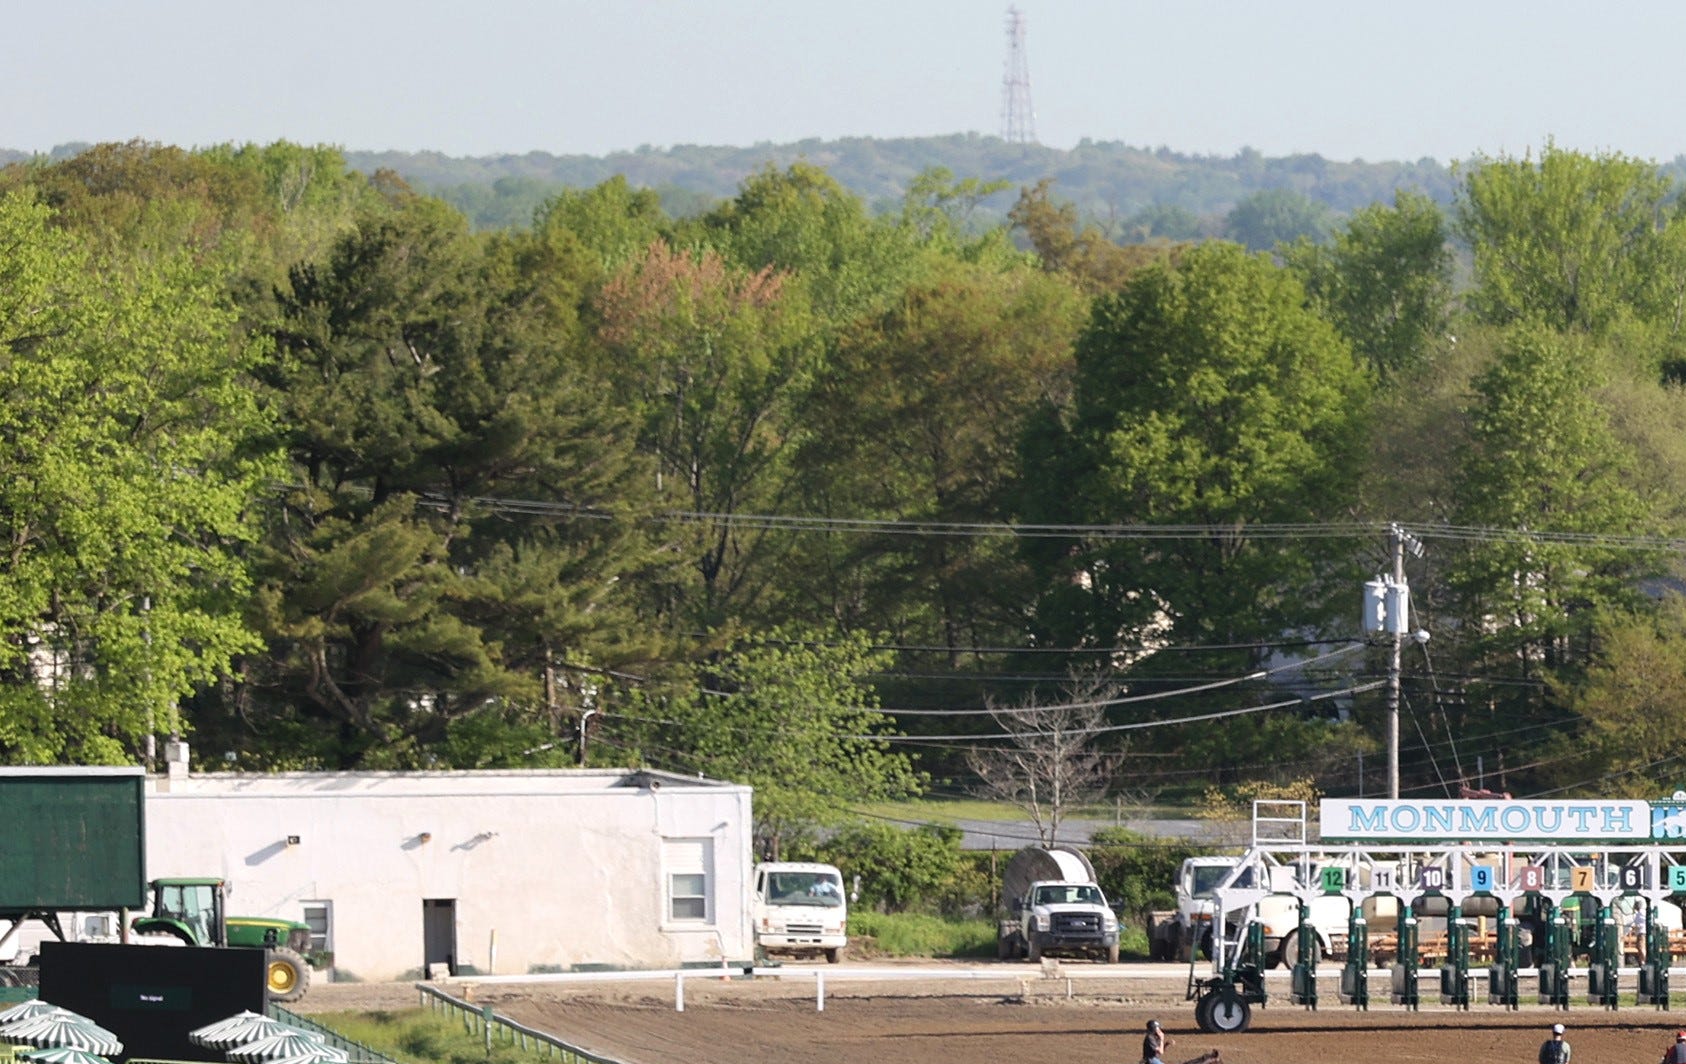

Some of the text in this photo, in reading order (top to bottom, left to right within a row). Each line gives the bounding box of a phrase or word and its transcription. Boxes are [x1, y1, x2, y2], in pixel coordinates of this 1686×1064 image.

[1348, 805, 1633, 833] MONMOUTH
[1325, 873, 1343, 887] 12
[1375, 873, 1391, 886] 11
[1423, 871, 1441, 886] 10
[1478, 871, 1487, 886] 9
[1527, 871, 1536, 886] 8
[1579, 871, 1587, 886] 7
[1625, 870, 1636, 885] 6
[1676, 870, 1685, 886] 5
